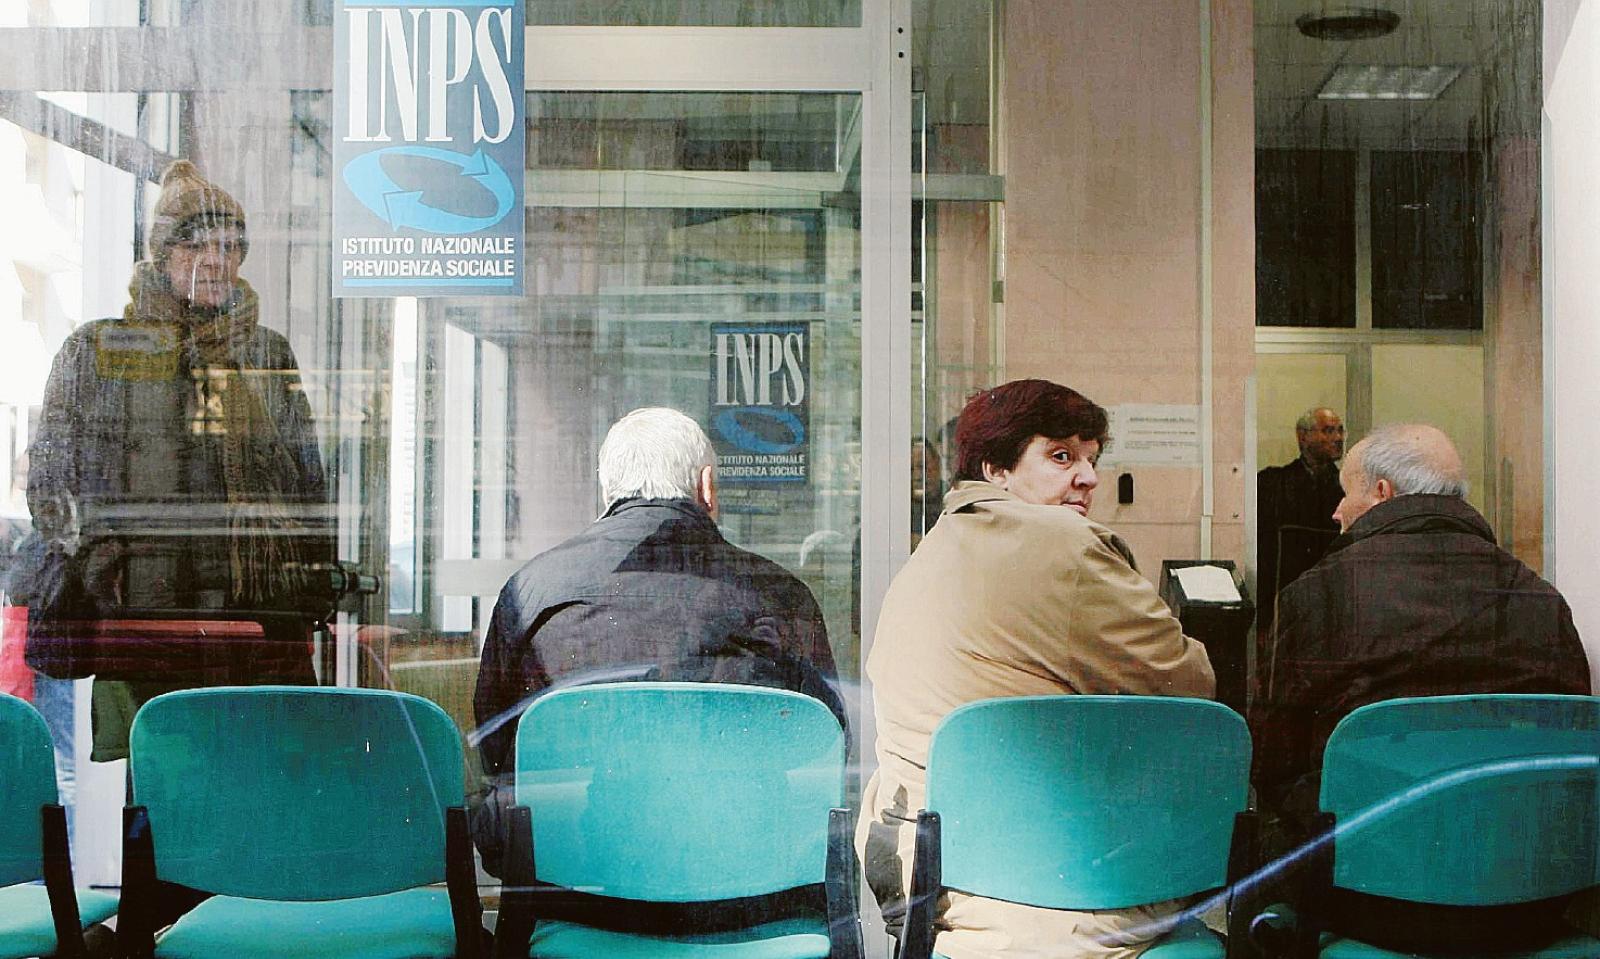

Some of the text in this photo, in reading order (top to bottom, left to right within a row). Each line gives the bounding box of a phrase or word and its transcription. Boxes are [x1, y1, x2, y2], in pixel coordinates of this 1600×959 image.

[343, 7, 515, 144] INPS
[342, 238, 515, 255] ISTITUTO NAZIONALE
[342, 260, 515, 277] PREVIDENZA SOCIALE
[715, 333, 805, 406] INPS
[717, 455, 806, 465] STITUTO NAZIONALE
[769, 466, 806, 476] SOCIALE
